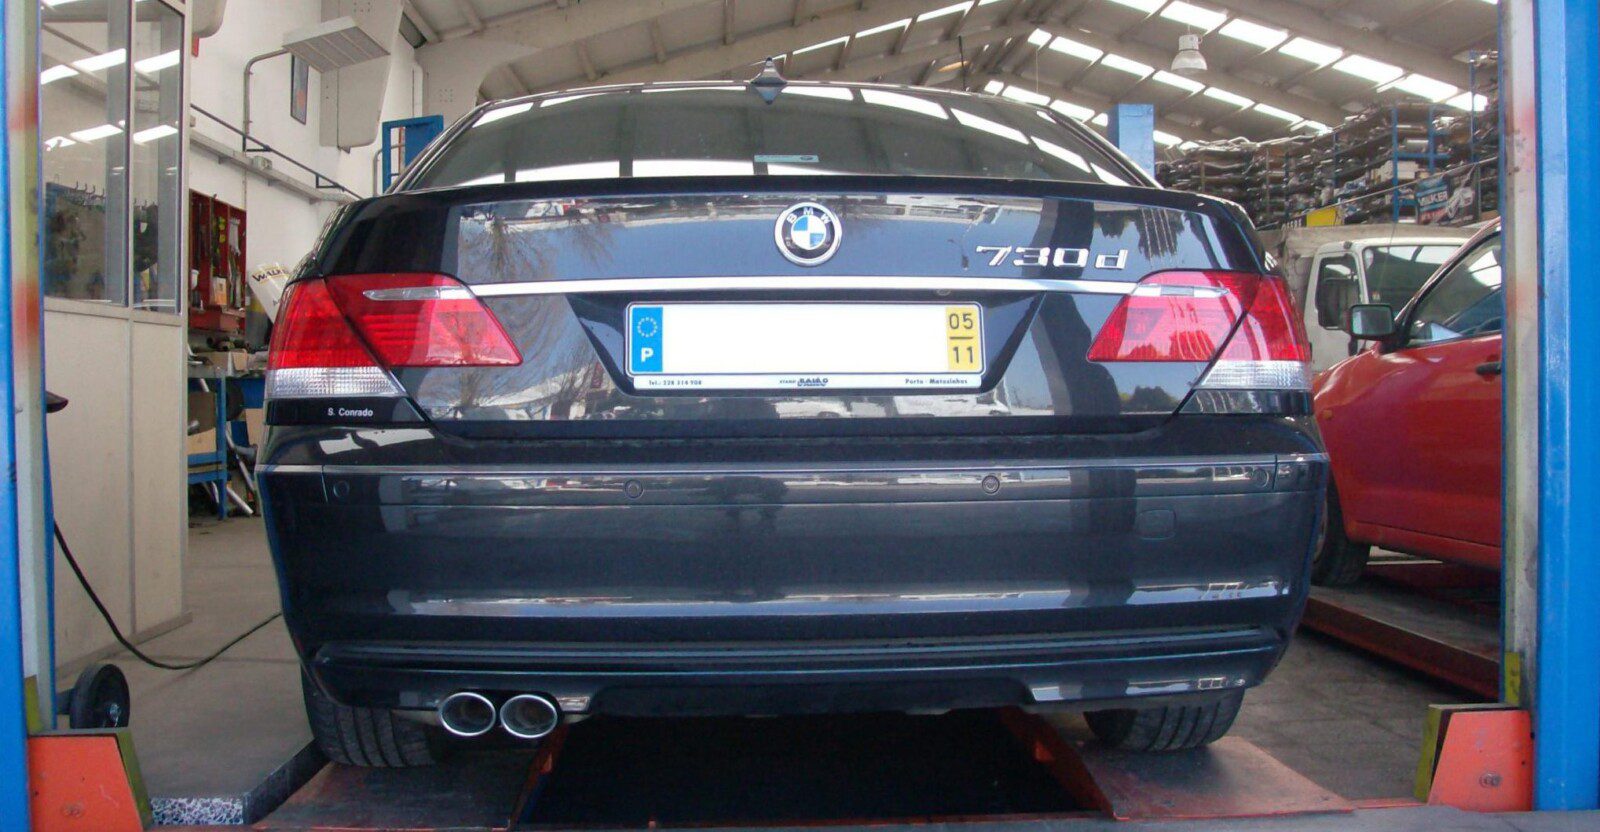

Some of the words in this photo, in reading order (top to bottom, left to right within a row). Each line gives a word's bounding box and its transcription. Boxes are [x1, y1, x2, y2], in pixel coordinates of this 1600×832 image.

[786, 206, 833, 226] BMW
[949, 313, 973, 330] 05
[641, 347, 654, 362] P
[953, 346, 973, 363] 11
[327, 407, 336, 416] S.
[338, 407, 374, 417] Conrado
